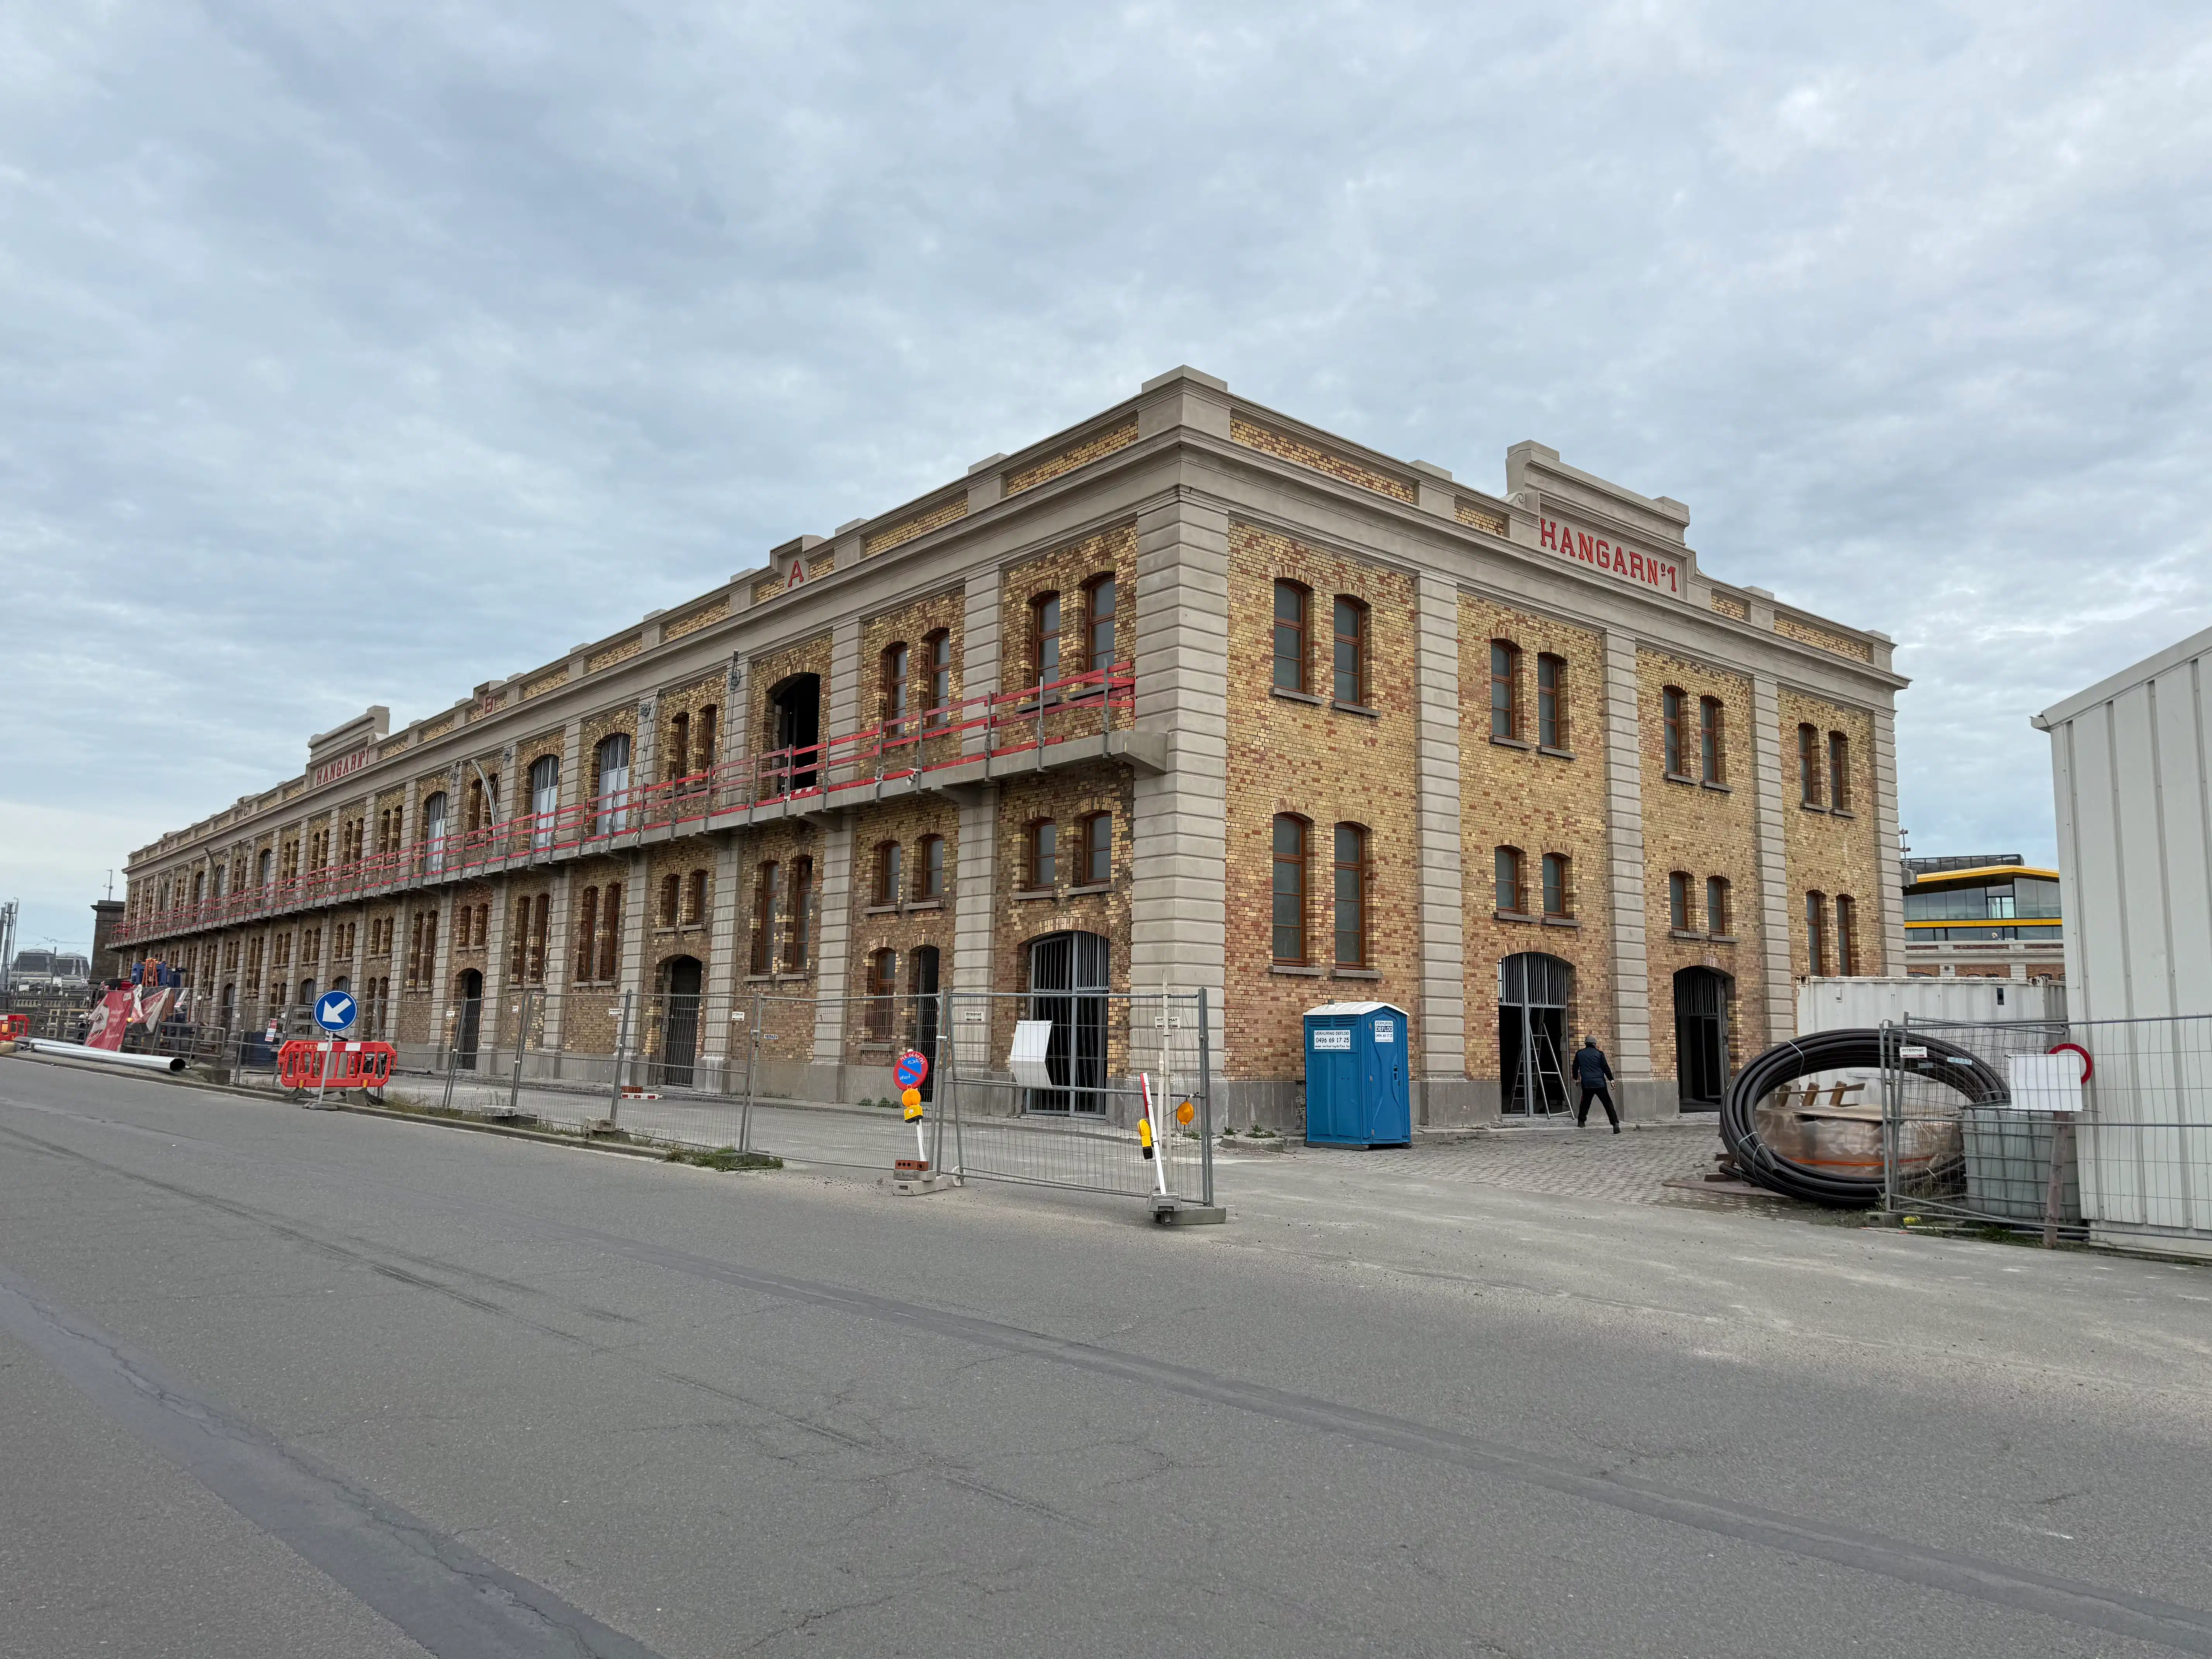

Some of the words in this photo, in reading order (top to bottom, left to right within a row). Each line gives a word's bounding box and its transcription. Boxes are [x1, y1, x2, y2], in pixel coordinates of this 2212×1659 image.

[1540, 517, 1645, 581] HANGAR
[788, 560, 804, 587] A
[484, 696, 493, 714] B
[316, 754, 357, 785] HANGAR
